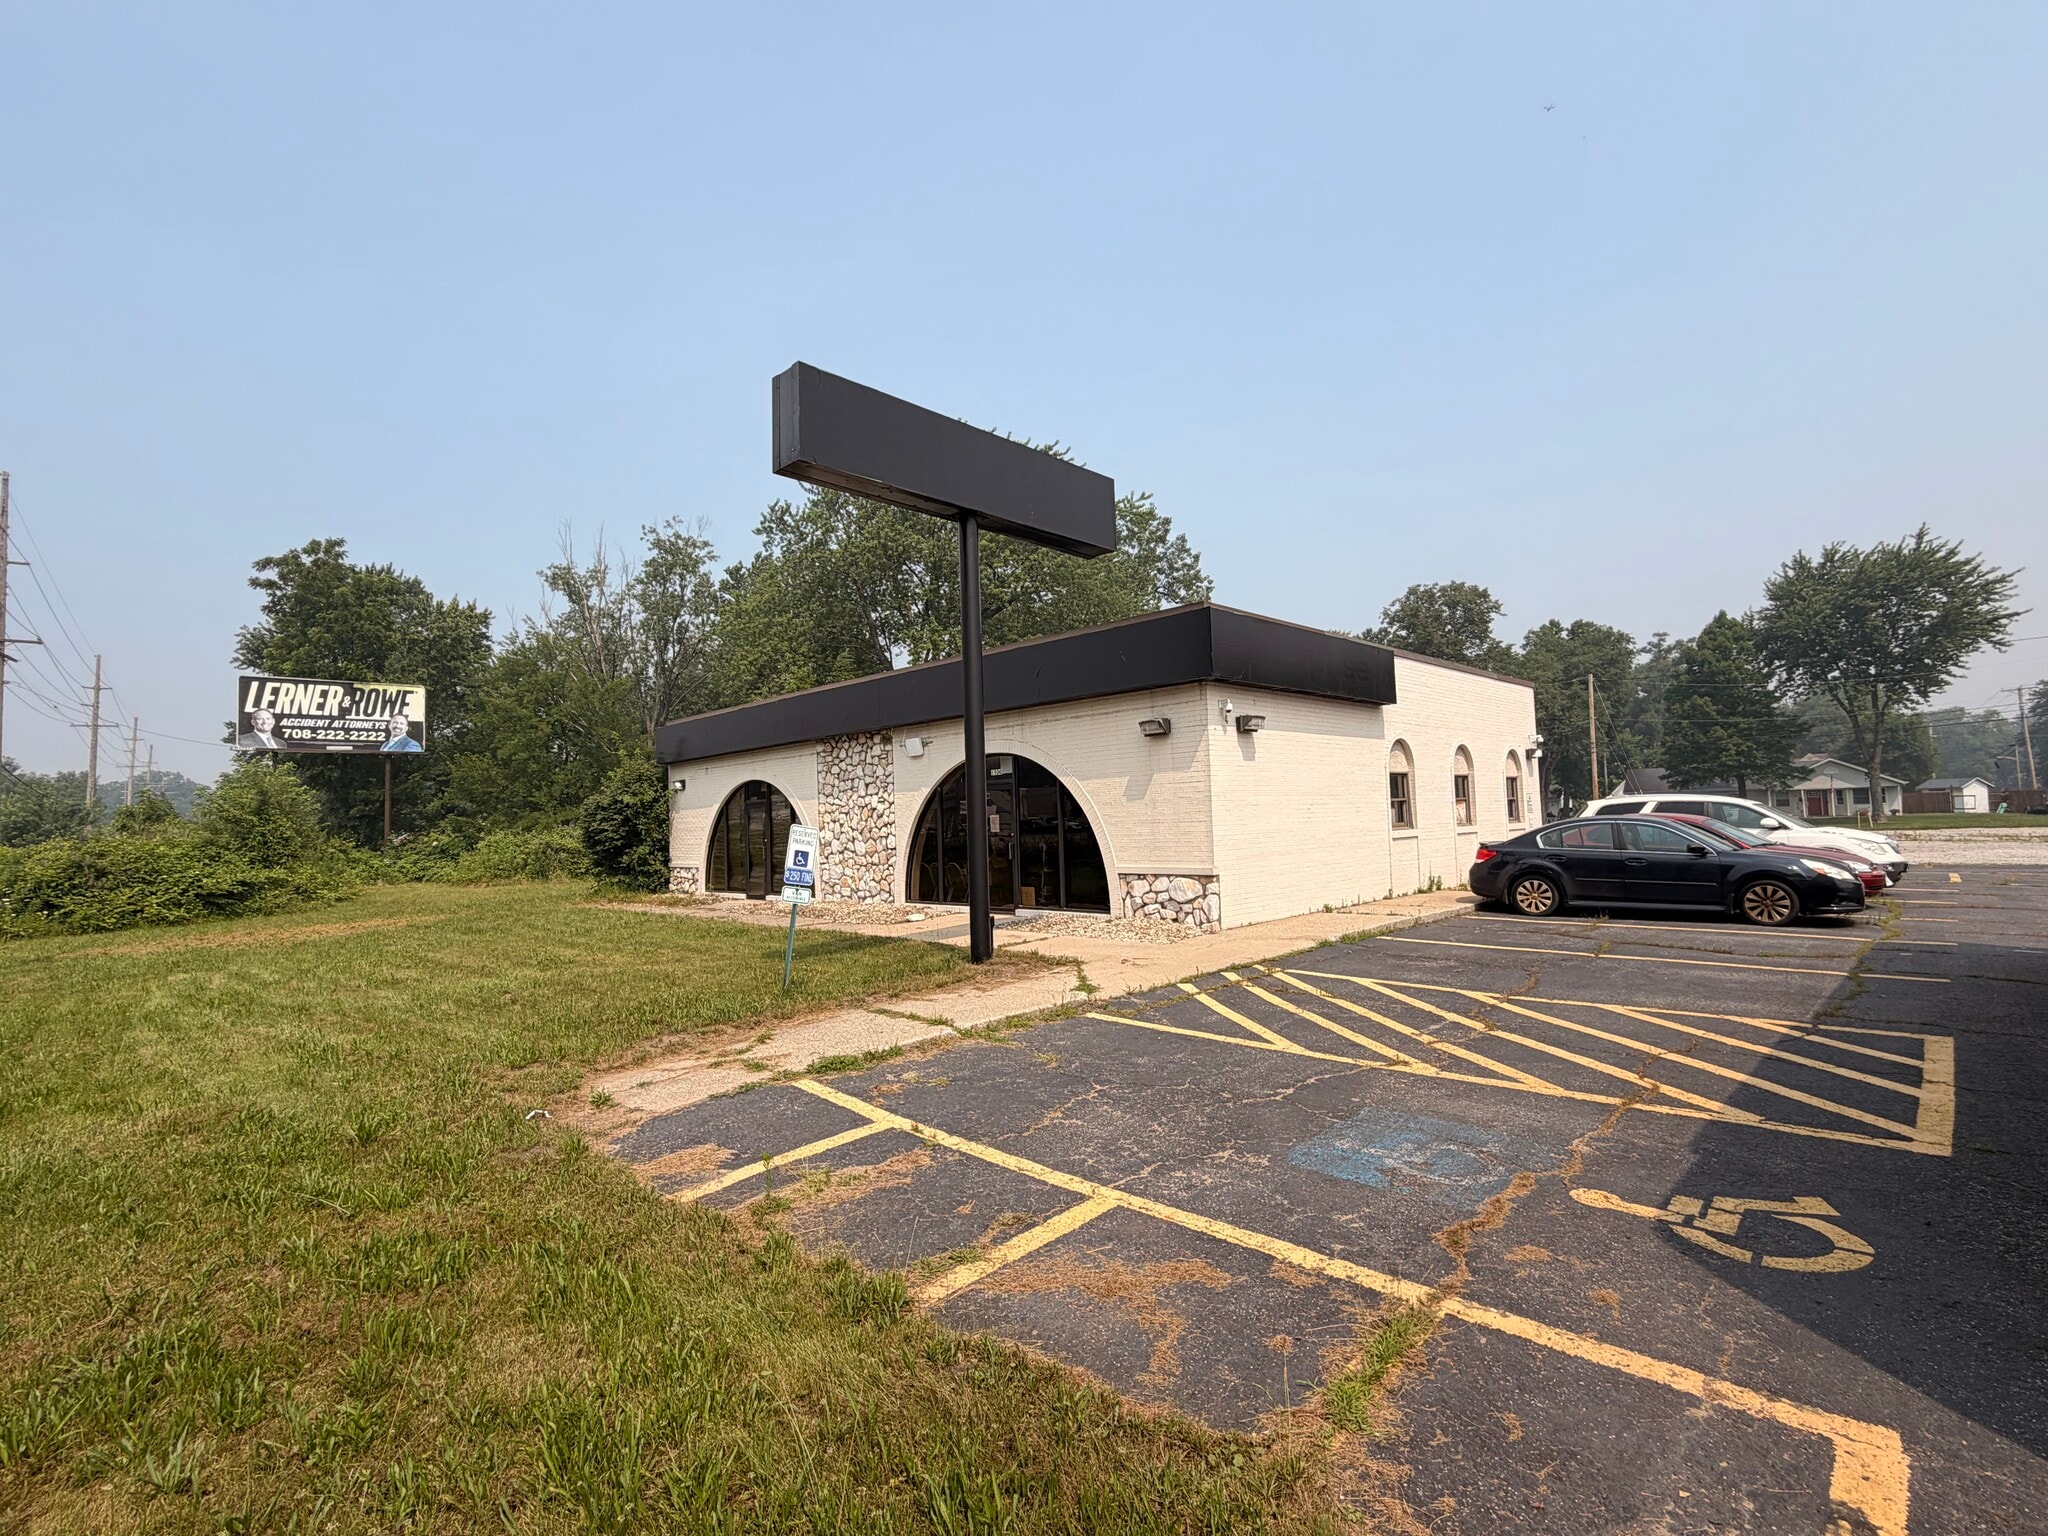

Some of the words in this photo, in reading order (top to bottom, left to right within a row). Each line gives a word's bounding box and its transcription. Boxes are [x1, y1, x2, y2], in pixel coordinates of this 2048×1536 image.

[244, 681, 344, 716] LERNER
[341, 696, 352, 708] &
[351, 687, 415, 718] ROWE
[280, 717, 331, 728] ACCIDENT
[331, 719, 388, 730] ATTORNEYS
[281, 729, 386, 741] 708-222-2222
[792, 829, 816, 839] RESERVED
[792, 838, 814, 847] PARKING
[801, 872, 814, 882] FINE
